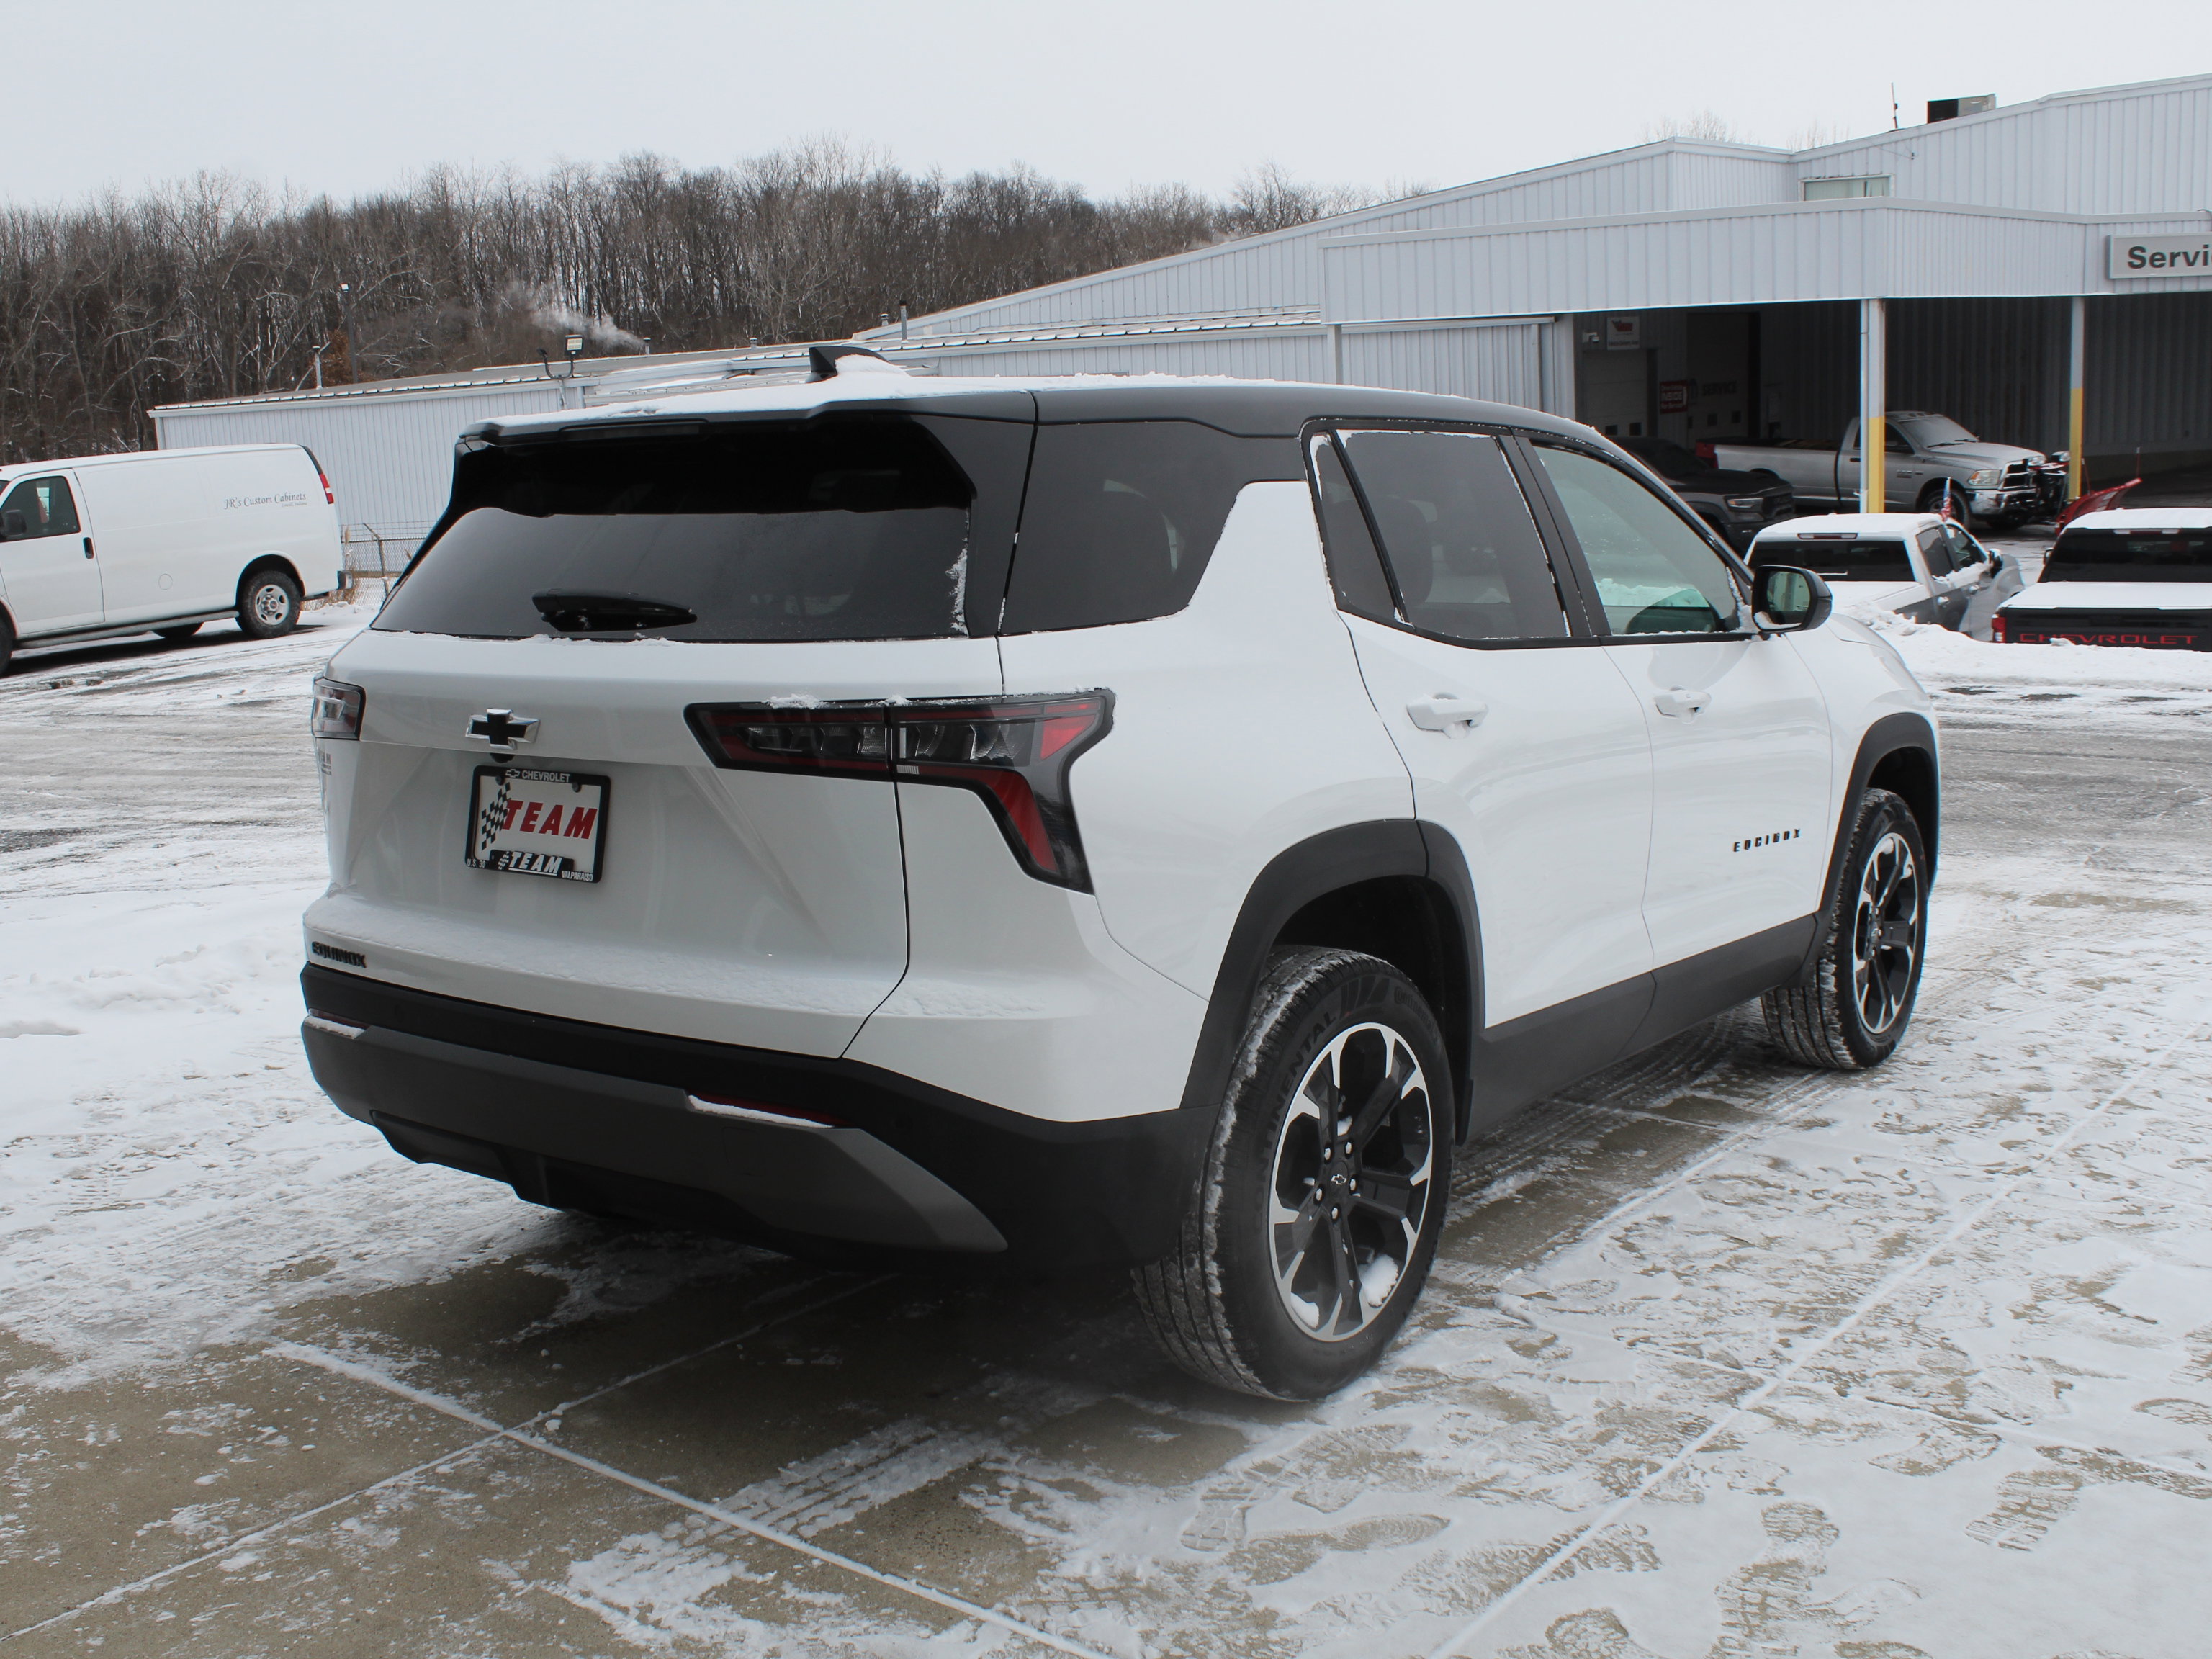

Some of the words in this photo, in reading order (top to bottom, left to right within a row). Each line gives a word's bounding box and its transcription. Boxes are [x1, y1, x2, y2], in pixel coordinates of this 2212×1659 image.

[2128, 244, 2212, 269] Servi
[243, 497, 272, 507] Custom
[274, 491, 307, 504] Cabinets
[522, 770, 571, 783] CHEVROLET
[502, 799, 598, 840] TEAM
[467, 858, 477, 867] U.S.
[479, 860, 486, 868] 30
[510, 852, 563, 873] TEAM
[562, 870, 593, 882] VALPARAISO
